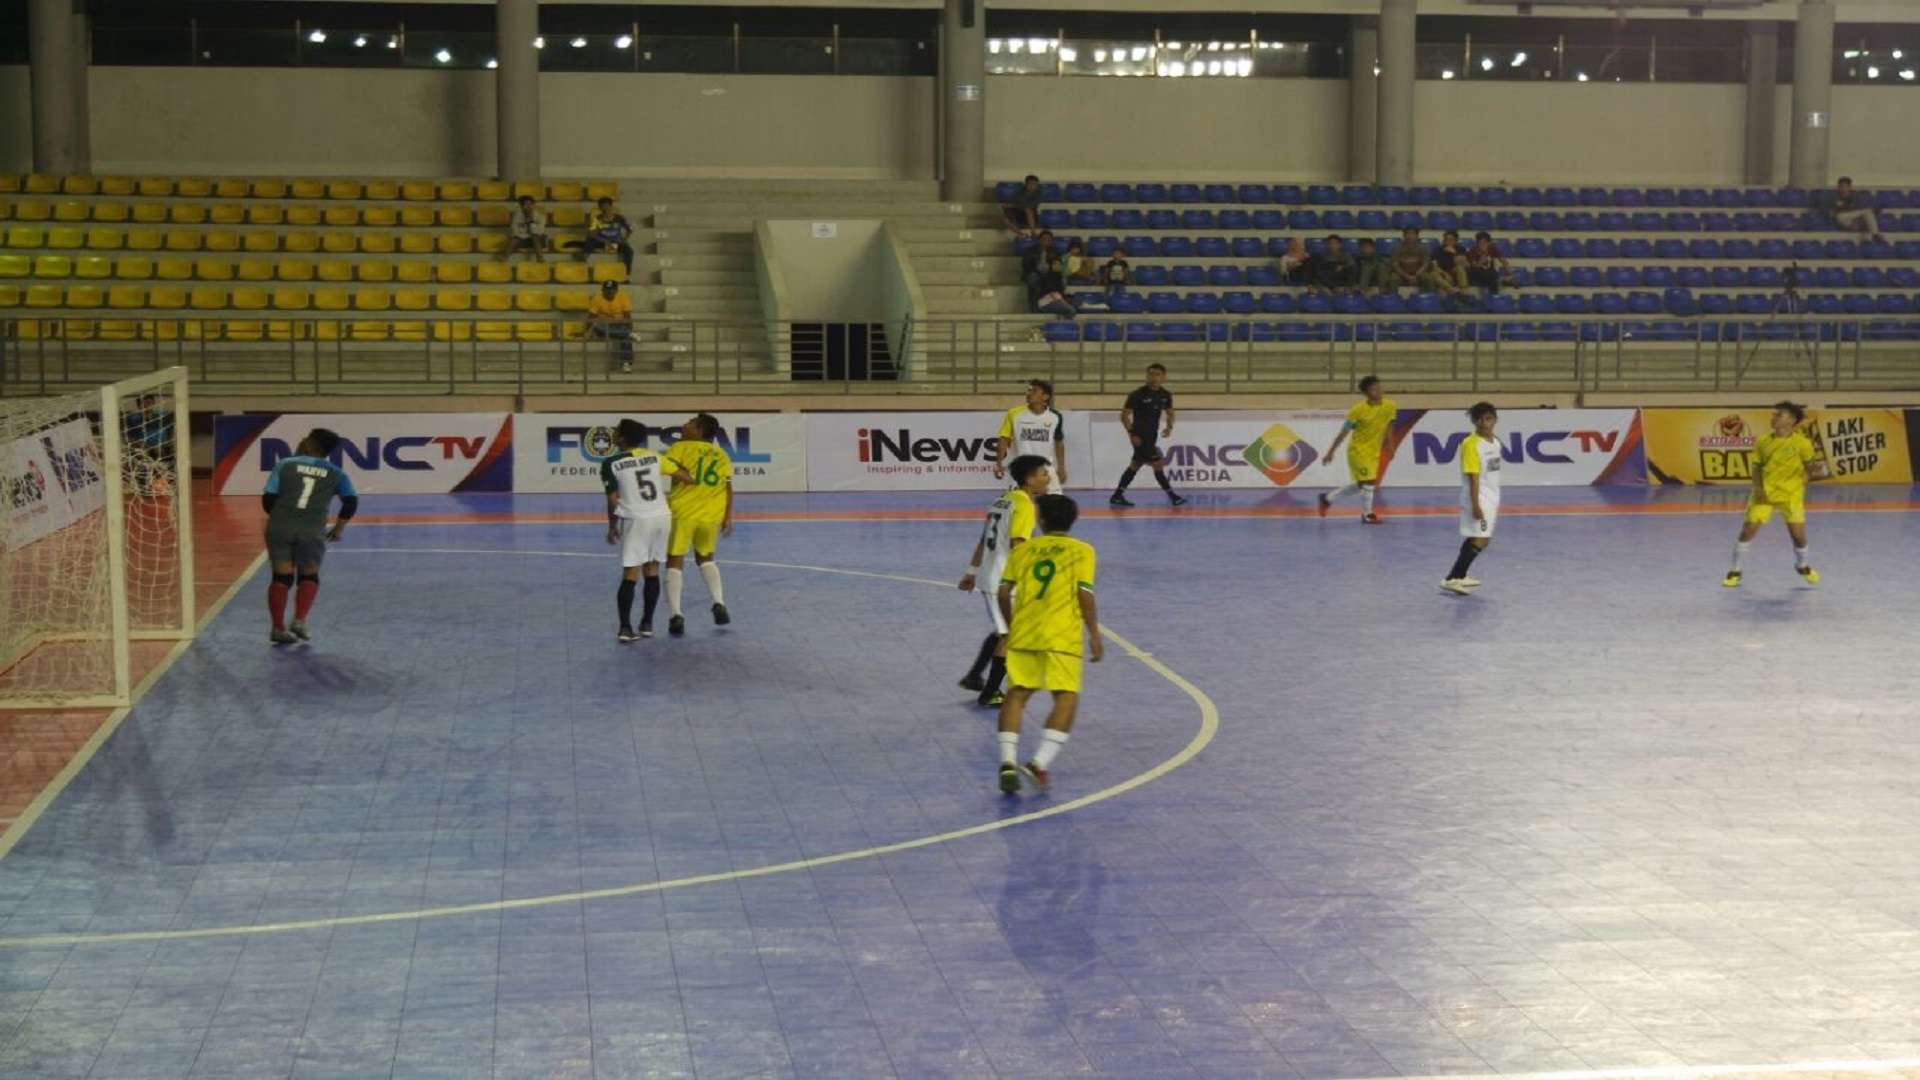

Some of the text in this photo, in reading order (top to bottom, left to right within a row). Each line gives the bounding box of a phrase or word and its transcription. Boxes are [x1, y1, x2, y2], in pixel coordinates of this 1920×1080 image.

[1826, 416, 1864, 438] LAKI
[1831, 433, 1886, 457] NEVER
[551, 466, 600, 476] FEDER
[695, 456, 720, 486] 16
[1167, 469, 1233, 482] MEDIA
[1836, 454, 1879, 476] STOP
[296, 476, 316, 509] 1
[635, 467, 658, 501] 5
[1034, 559, 1056, 600] 9
